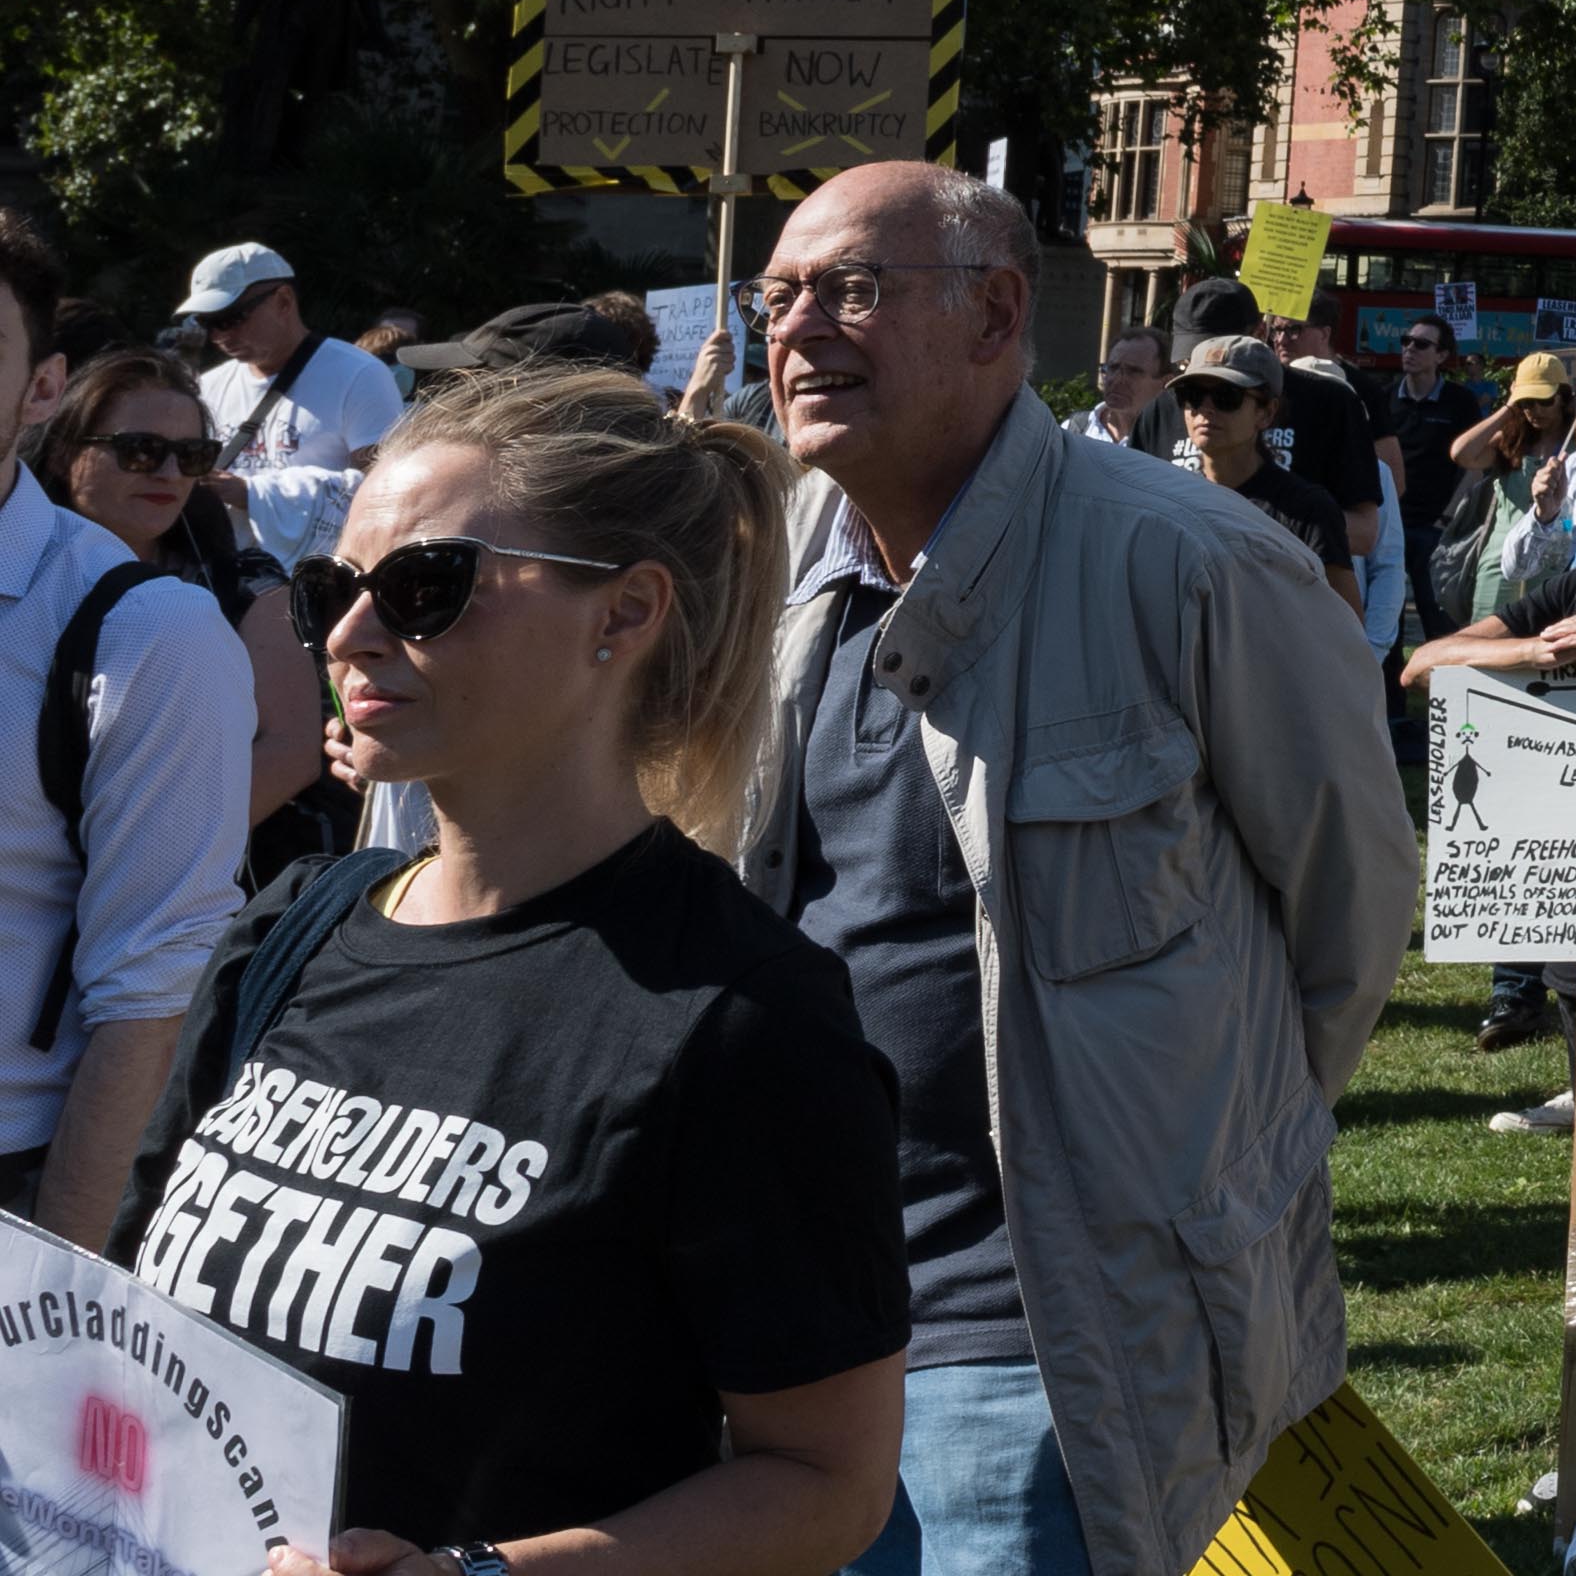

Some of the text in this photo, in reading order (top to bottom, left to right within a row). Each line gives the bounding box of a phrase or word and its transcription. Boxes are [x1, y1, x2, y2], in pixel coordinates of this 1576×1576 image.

[544, 43, 881, 88] LEGISLATE NOW
[543, 112, 907, 138] PROTECTION BANKRUPTCY
[1507, 736, 1554, 755] ENOUGH
[1428, 697, 1447, 824] LEASEHOLDER
[1446, 838, 1500, 859] STOP
[1434, 861, 1516, 884] PENSION
[1432, 899, 1500, 918] SUCKING
[1504, 902, 1529, 916] THE
[1431, 924, 1469, 940] OUT
[1477, 922, 1499, 939] OF
[83, 1396, 146, 1493] NO
